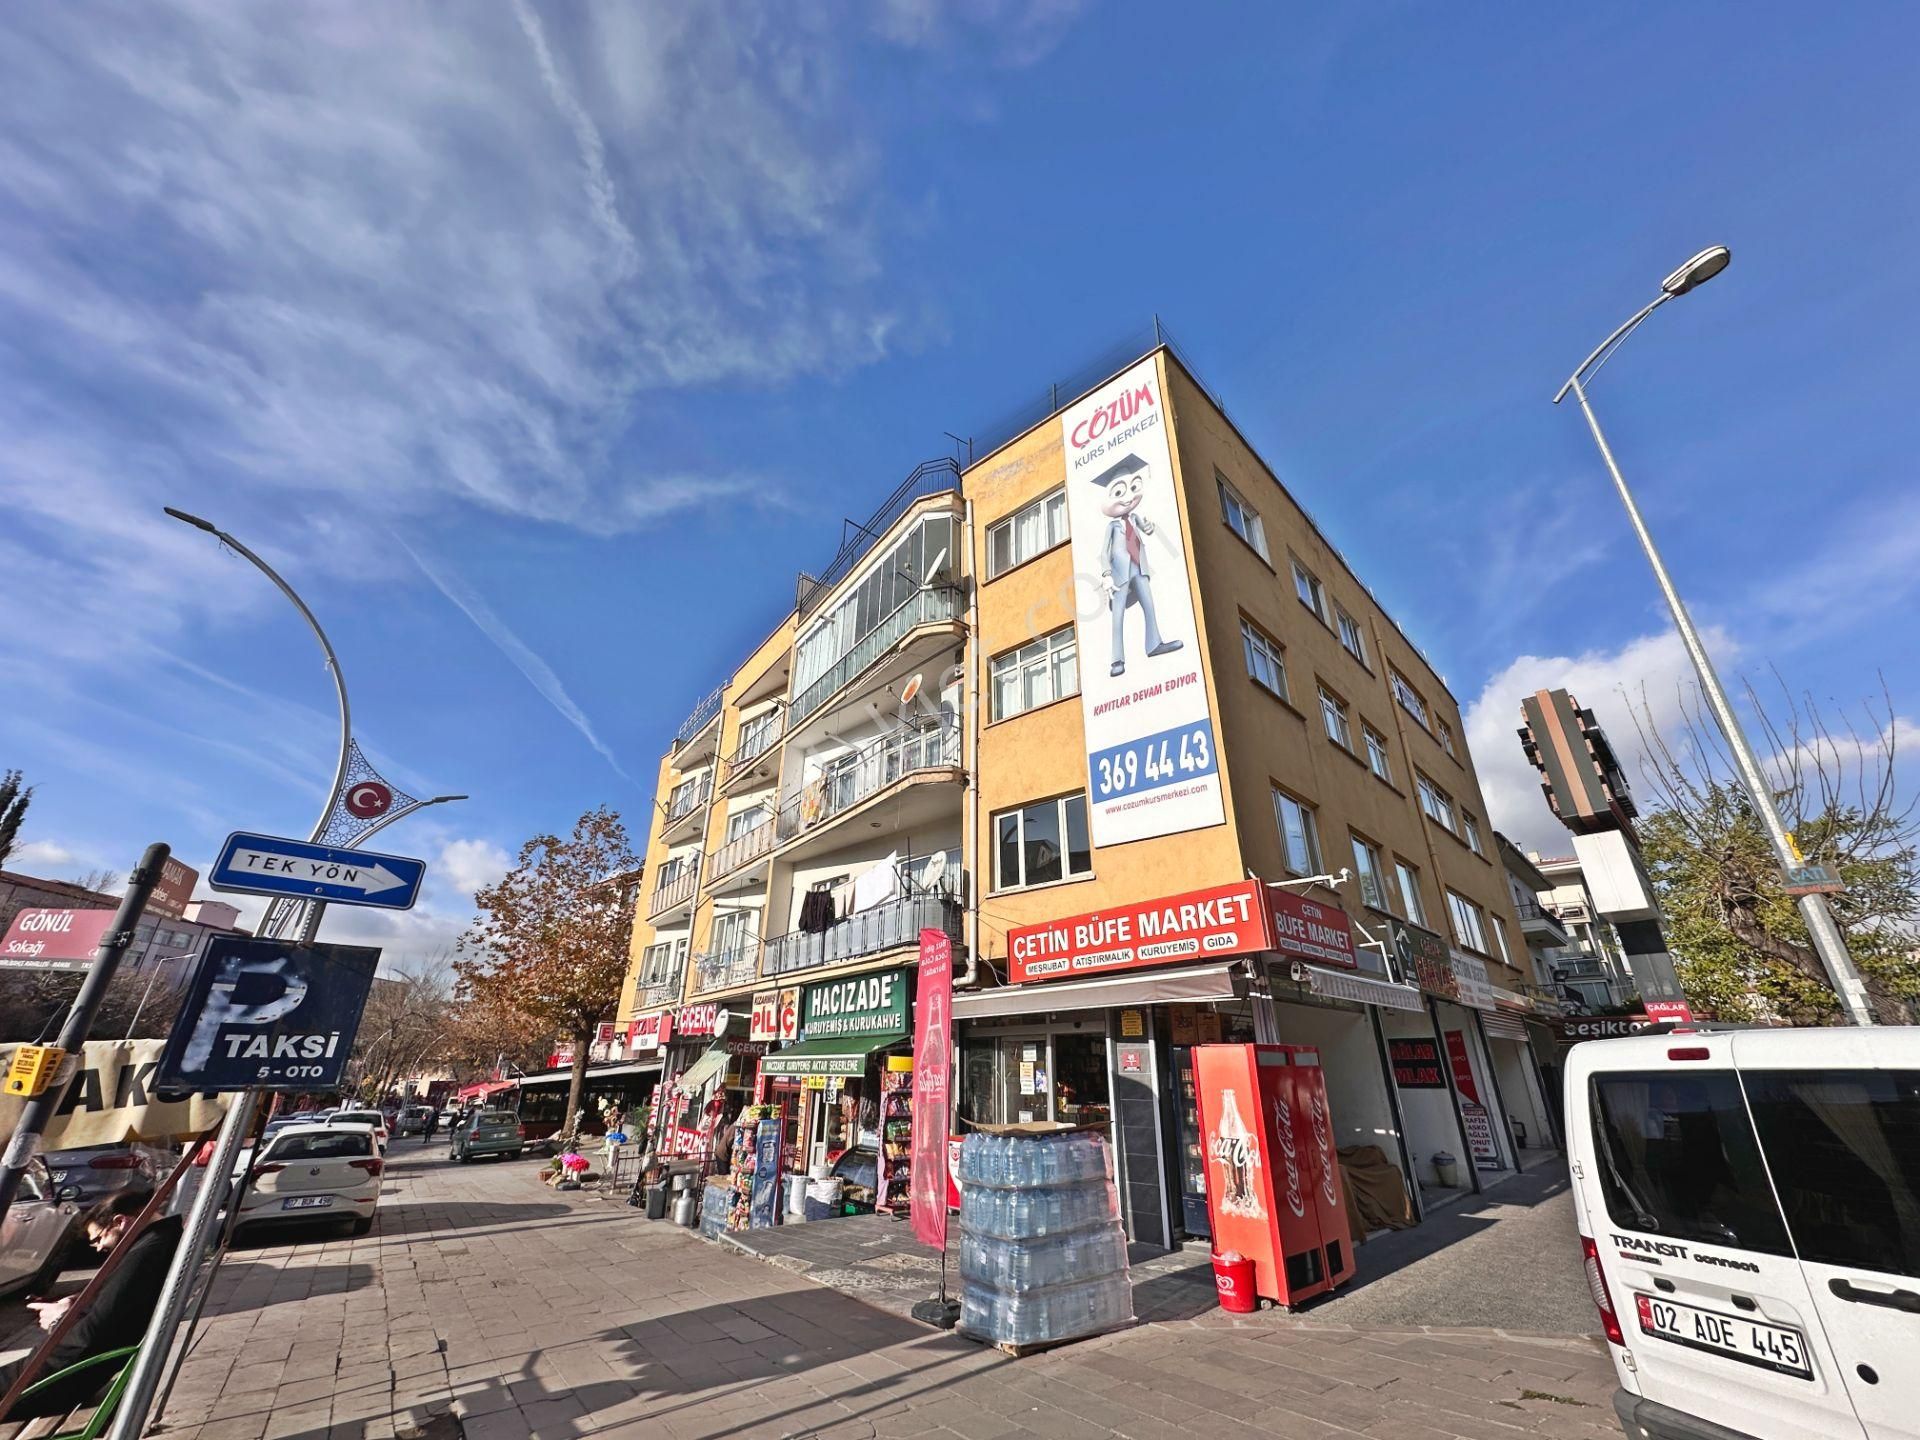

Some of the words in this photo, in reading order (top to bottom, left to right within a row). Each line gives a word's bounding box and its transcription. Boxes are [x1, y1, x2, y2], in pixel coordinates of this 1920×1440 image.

[1071, 383, 1154, 449] ÇÖZÜM
[1075, 445, 1105, 470] KURS
[1093, 694, 1131, 716] KAYITLAR
[1133, 684, 1162, 702] DEVAM
[1099, 750, 1138, 795] 369
[1145, 740, 1174, 782] 44
[1179, 730, 1210, 772] 43
[1105, 783, 1208, 815] www.cozumkursmerkezi.com
[247, 854, 297, 873] TEK
[310, 863, 359, 882] YÖN
[20, 909, 74, 932] GÖNÜL
[1301, 903, 1322, 919] ÇETİN
[1013, 925, 1069, 965] ÇETİN
[1075, 915, 1132, 949] BÜFE
[1138, 893, 1252, 938] MARKET
[1275, 908, 1306, 938] BÜFE
[1307, 921, 1349, 950] MARKET
[5, 940, 45, 956] Sokağı
[1028, 961, 1066, 974] MEŞRUBAT
[1075, 951, 1131, 968] ATIŞTIRMALIK
[1140, 940, 1196, 958] KURUYEMİŞ
[1207, 935, 1234, 948] GIDA
[812, 974, 892, 1017] HACIZADE
[1647, 1003, 1686, 1011] ÇAĞLAR
[181, 956, 308, 1072] P
[681, 1005, 717, 1035] ÇİÇEKÇİ
[805, 1018, 842, 1036] KURUYEMİŞ
[849, 1013, 901, 1030] KURUKAHVE
[224, 1031, 341, 1059] TAKSİ
[812, 1060, 827, 1071] AKTAR
[829, 1060, 858, 1073] ŞEKERLEME
[1273, 1095, 1305, 1217] Coca-Cola
[1609, 1233, 1688, 1259] TRANSIT
[1693, 1253, 1760, 1274] connect
[1652, 1303, 1681, 1333] 02
[1694, 1313, 1737, 1349] ADE
[1752, 1327, 1800, 1364] 445
